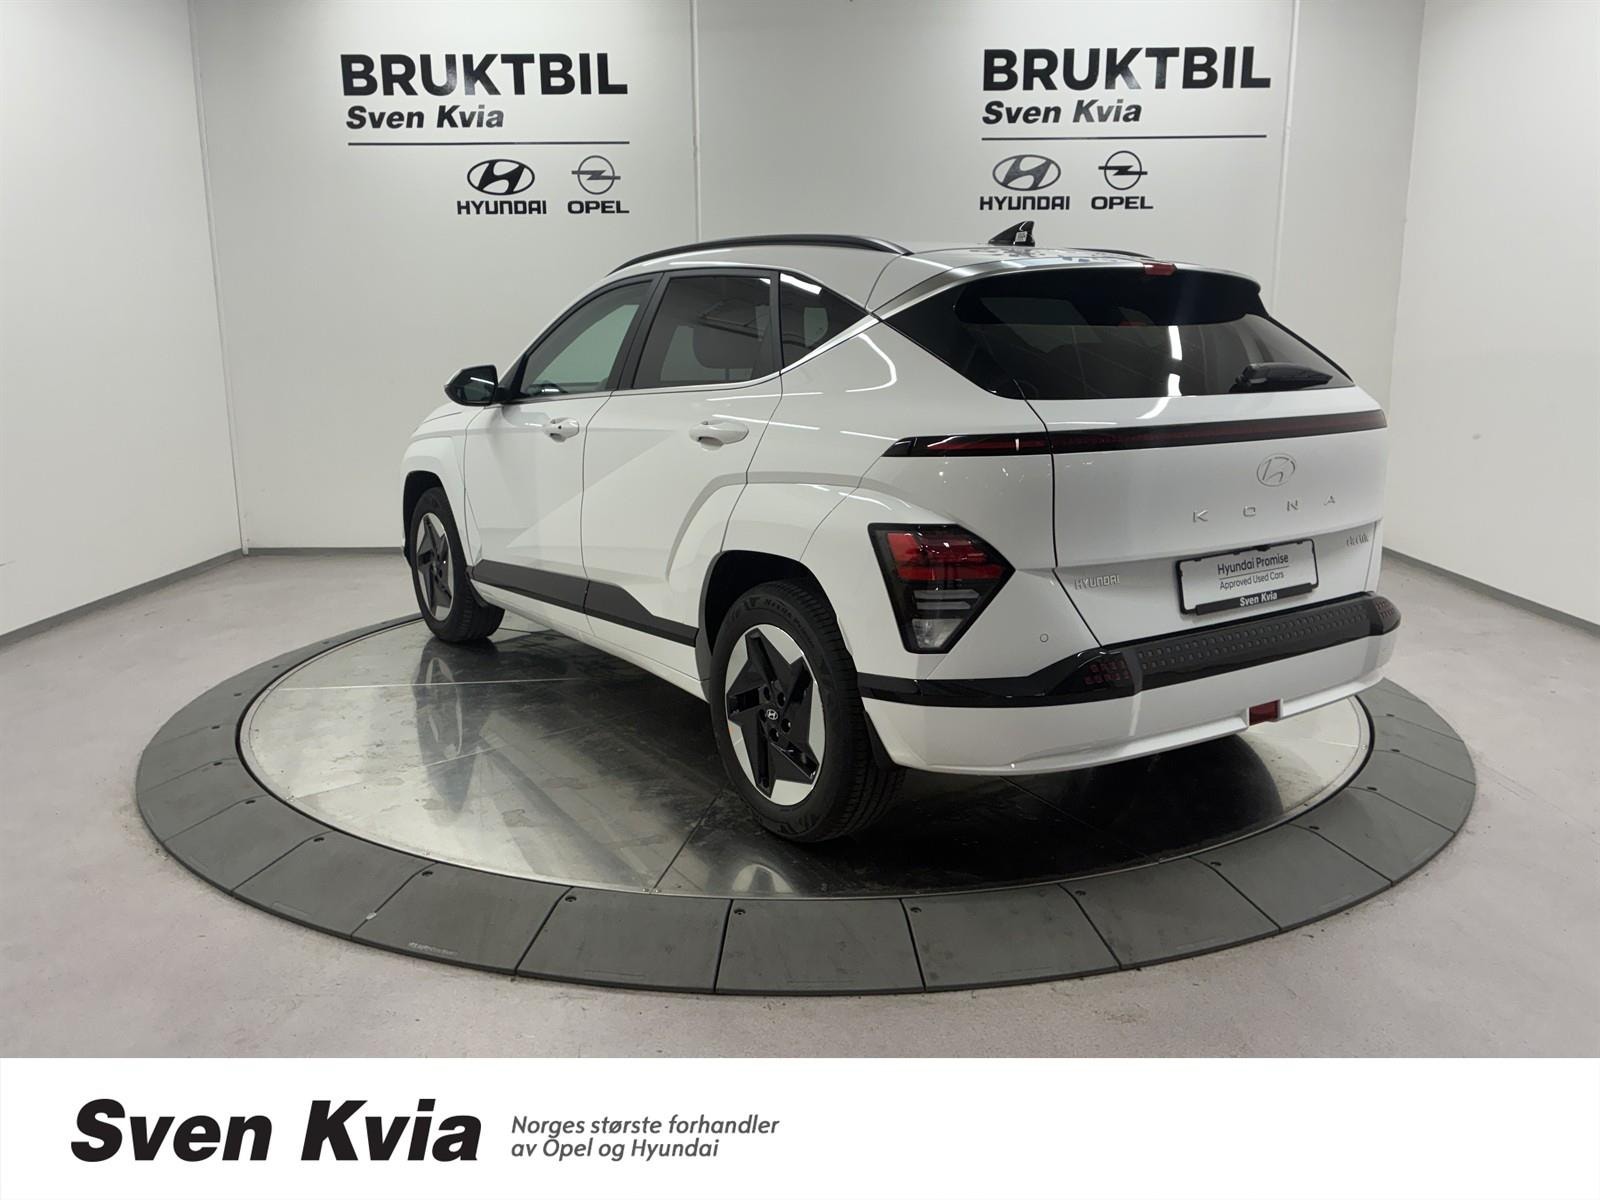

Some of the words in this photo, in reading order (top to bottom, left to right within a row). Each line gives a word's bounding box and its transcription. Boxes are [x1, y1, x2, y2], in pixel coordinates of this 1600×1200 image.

[340, 52, 628, 97] BRUKTBIL
[983, 46, 1271, 92] BRUKTBIL
[346, 105, 425, 130] Sven
[436, 104, 505, 129] Kvia
[982, 100, 1062, 125] Sven
[1072, 98, 1142, 123] Kvia
[456, 200, 547, 215] HYUNDAI
[567, 200, 630, 215] OPEL
[979, 195, 1071, 211] HYUNDAI
[1090, 195, 1154, 210] OPEL
[1192, 495, 1336, 523] KONA
[1217, 560, 1255, 576] Hyundai
[1256, 553, 1289, 569] Promise
[1074, 574, 1121, 590] HYUNDAI
[1220, 577, 1252, 591] Approved
[1253, 574, 1269, 584] Used
[1270, 570, 1285, 581] Cars
[1240, 596, 1260, 607] Sven
[1260, 591, 1278, 602] Kvia
